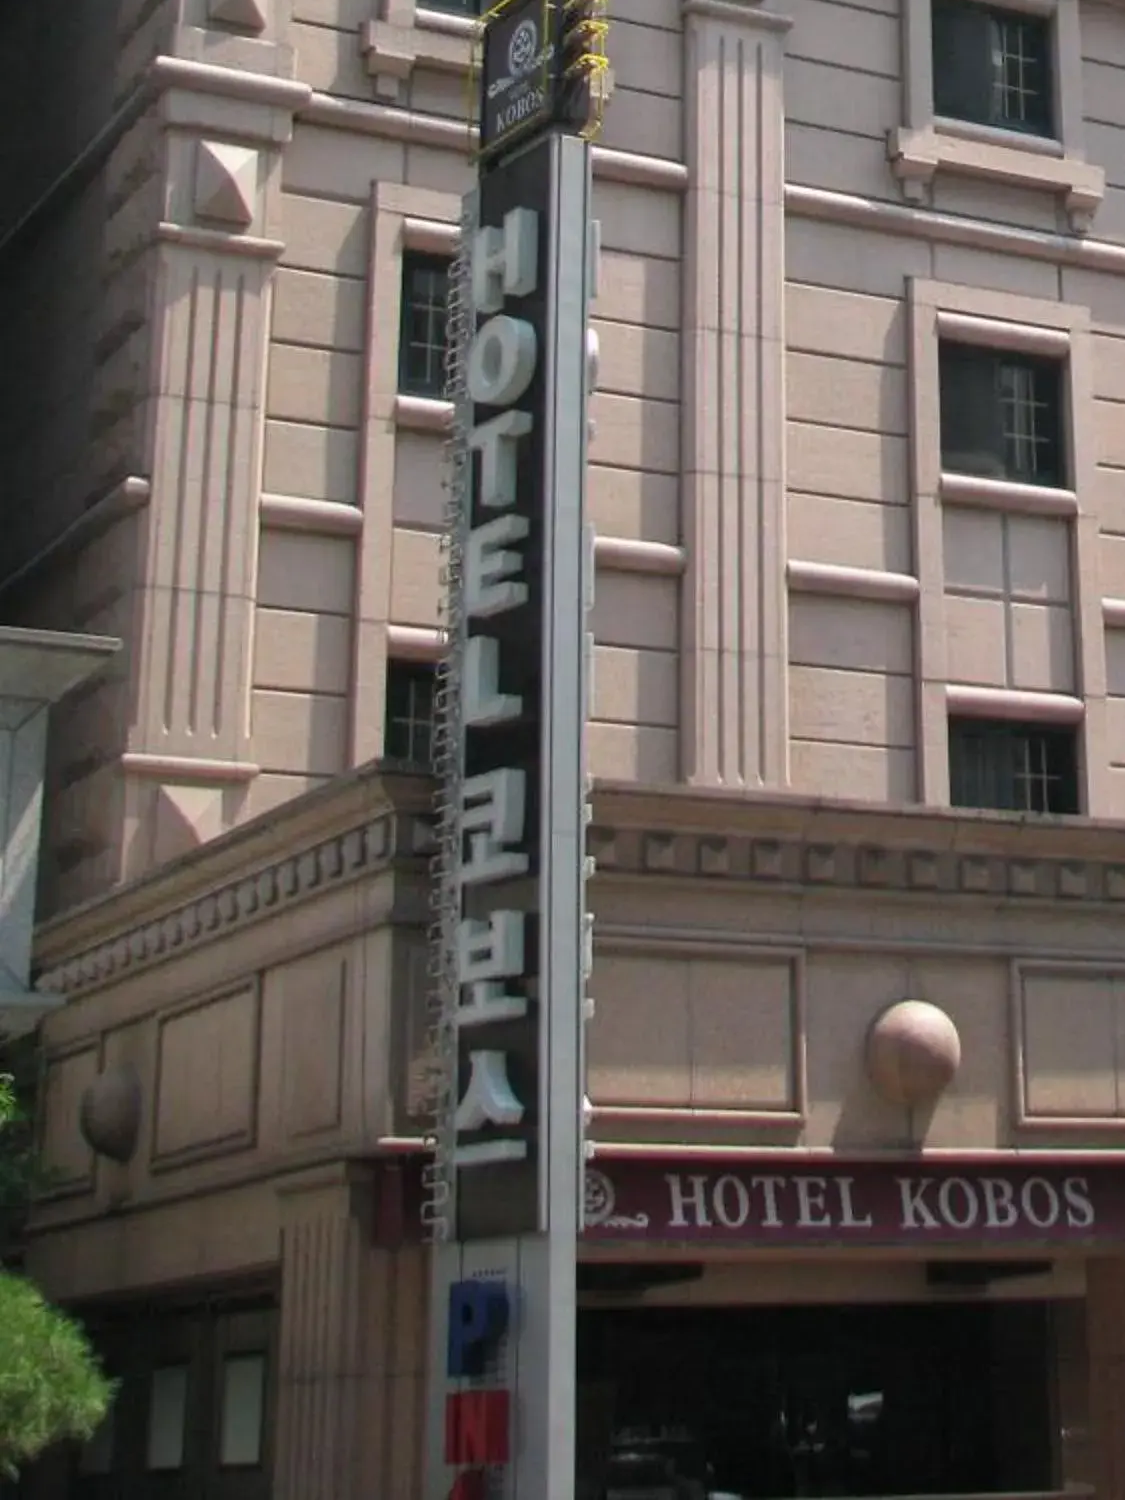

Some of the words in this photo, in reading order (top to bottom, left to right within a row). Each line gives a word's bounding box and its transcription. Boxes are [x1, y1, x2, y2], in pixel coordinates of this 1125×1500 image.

[463, 206, 538, 728] HOTEL
[455, 767, 529, 1166] 코보스
[665, 1173, 873, 1229] HOTEL
[895, 1177, 1096, 1229] KOBOS
